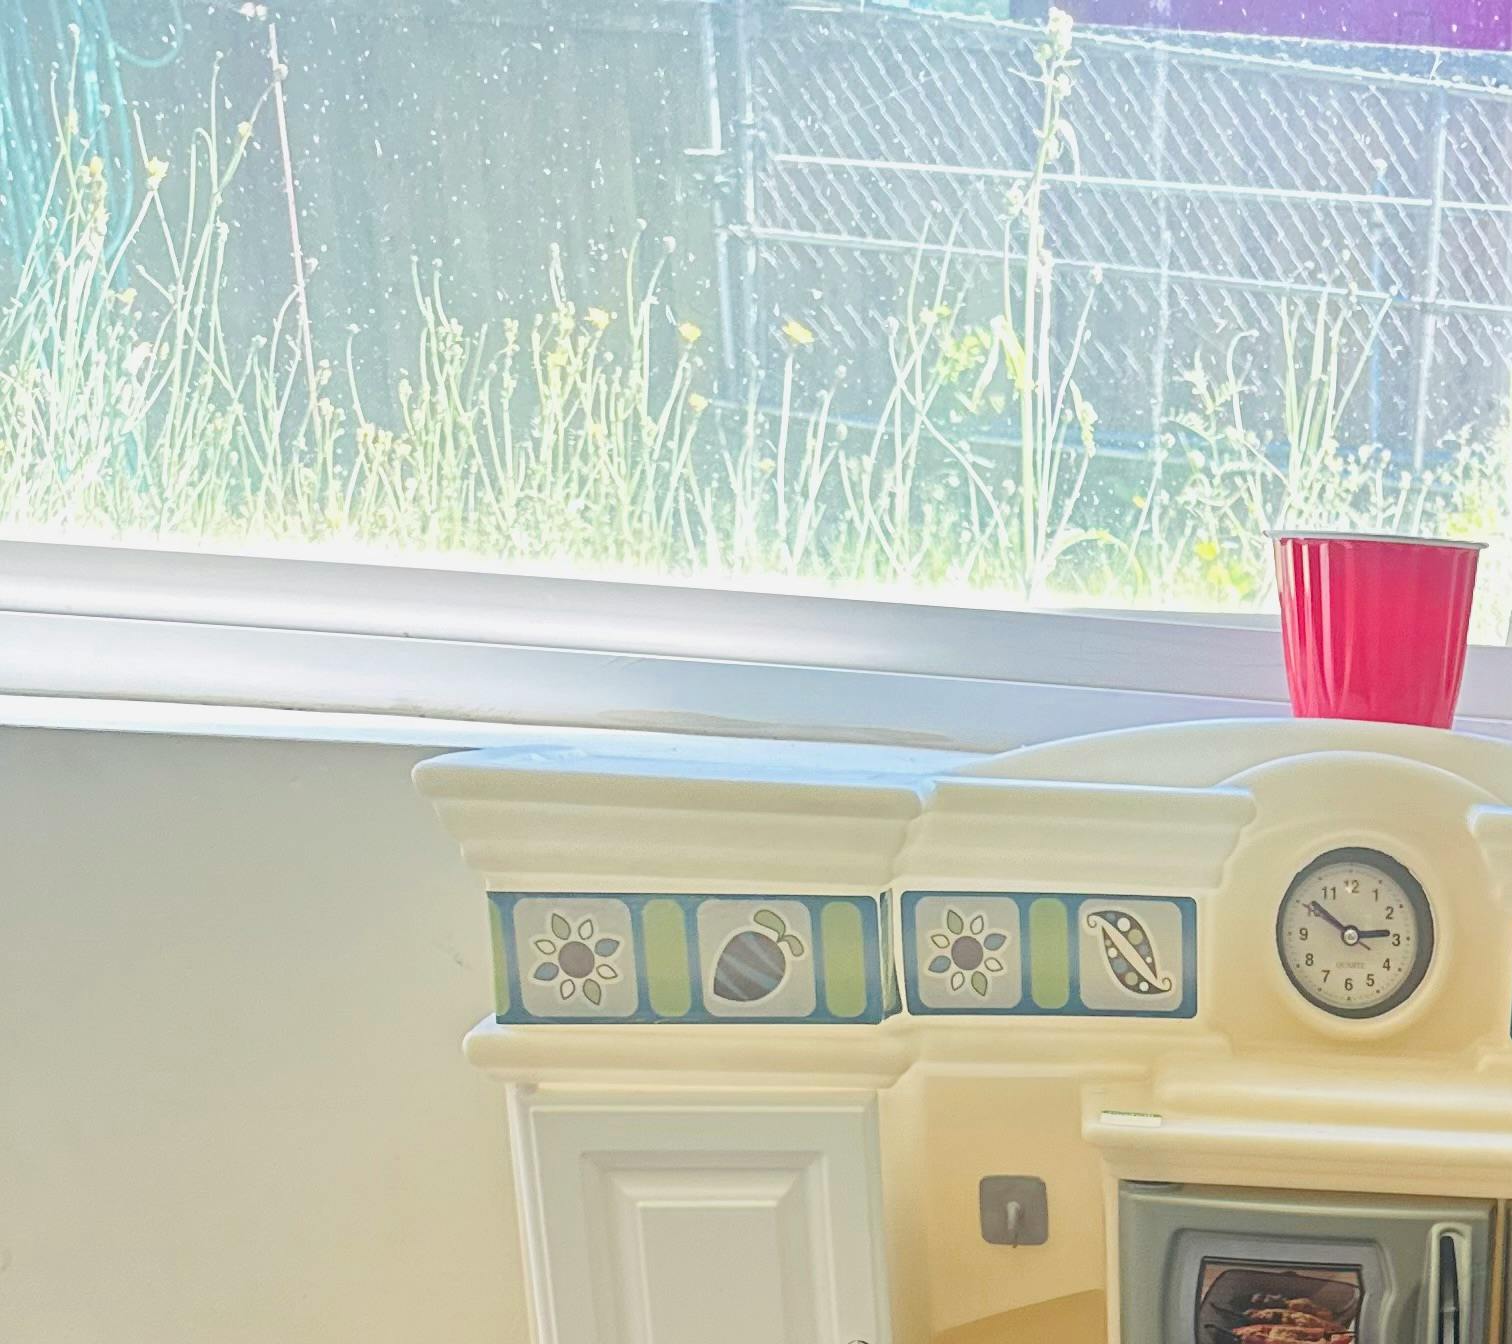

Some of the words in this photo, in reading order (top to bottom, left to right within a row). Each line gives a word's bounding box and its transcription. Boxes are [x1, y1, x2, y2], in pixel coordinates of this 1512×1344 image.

[1321, 886, 1337, 900] 11
[1372, 888, 1379, 901] 1
[1385, 906, 1394, 920] 2
[1299, 927, 1308, 941] 9
[1391, 933, 1401, 947] 3
[1305, 953, 1314, 967] 8
[1382, 958, 1391, 971] 4
[1321, 969, 1331, 983] 7
[1366, 973, 1375, 987] 5
[1344, 978, 1353, 991] 6
